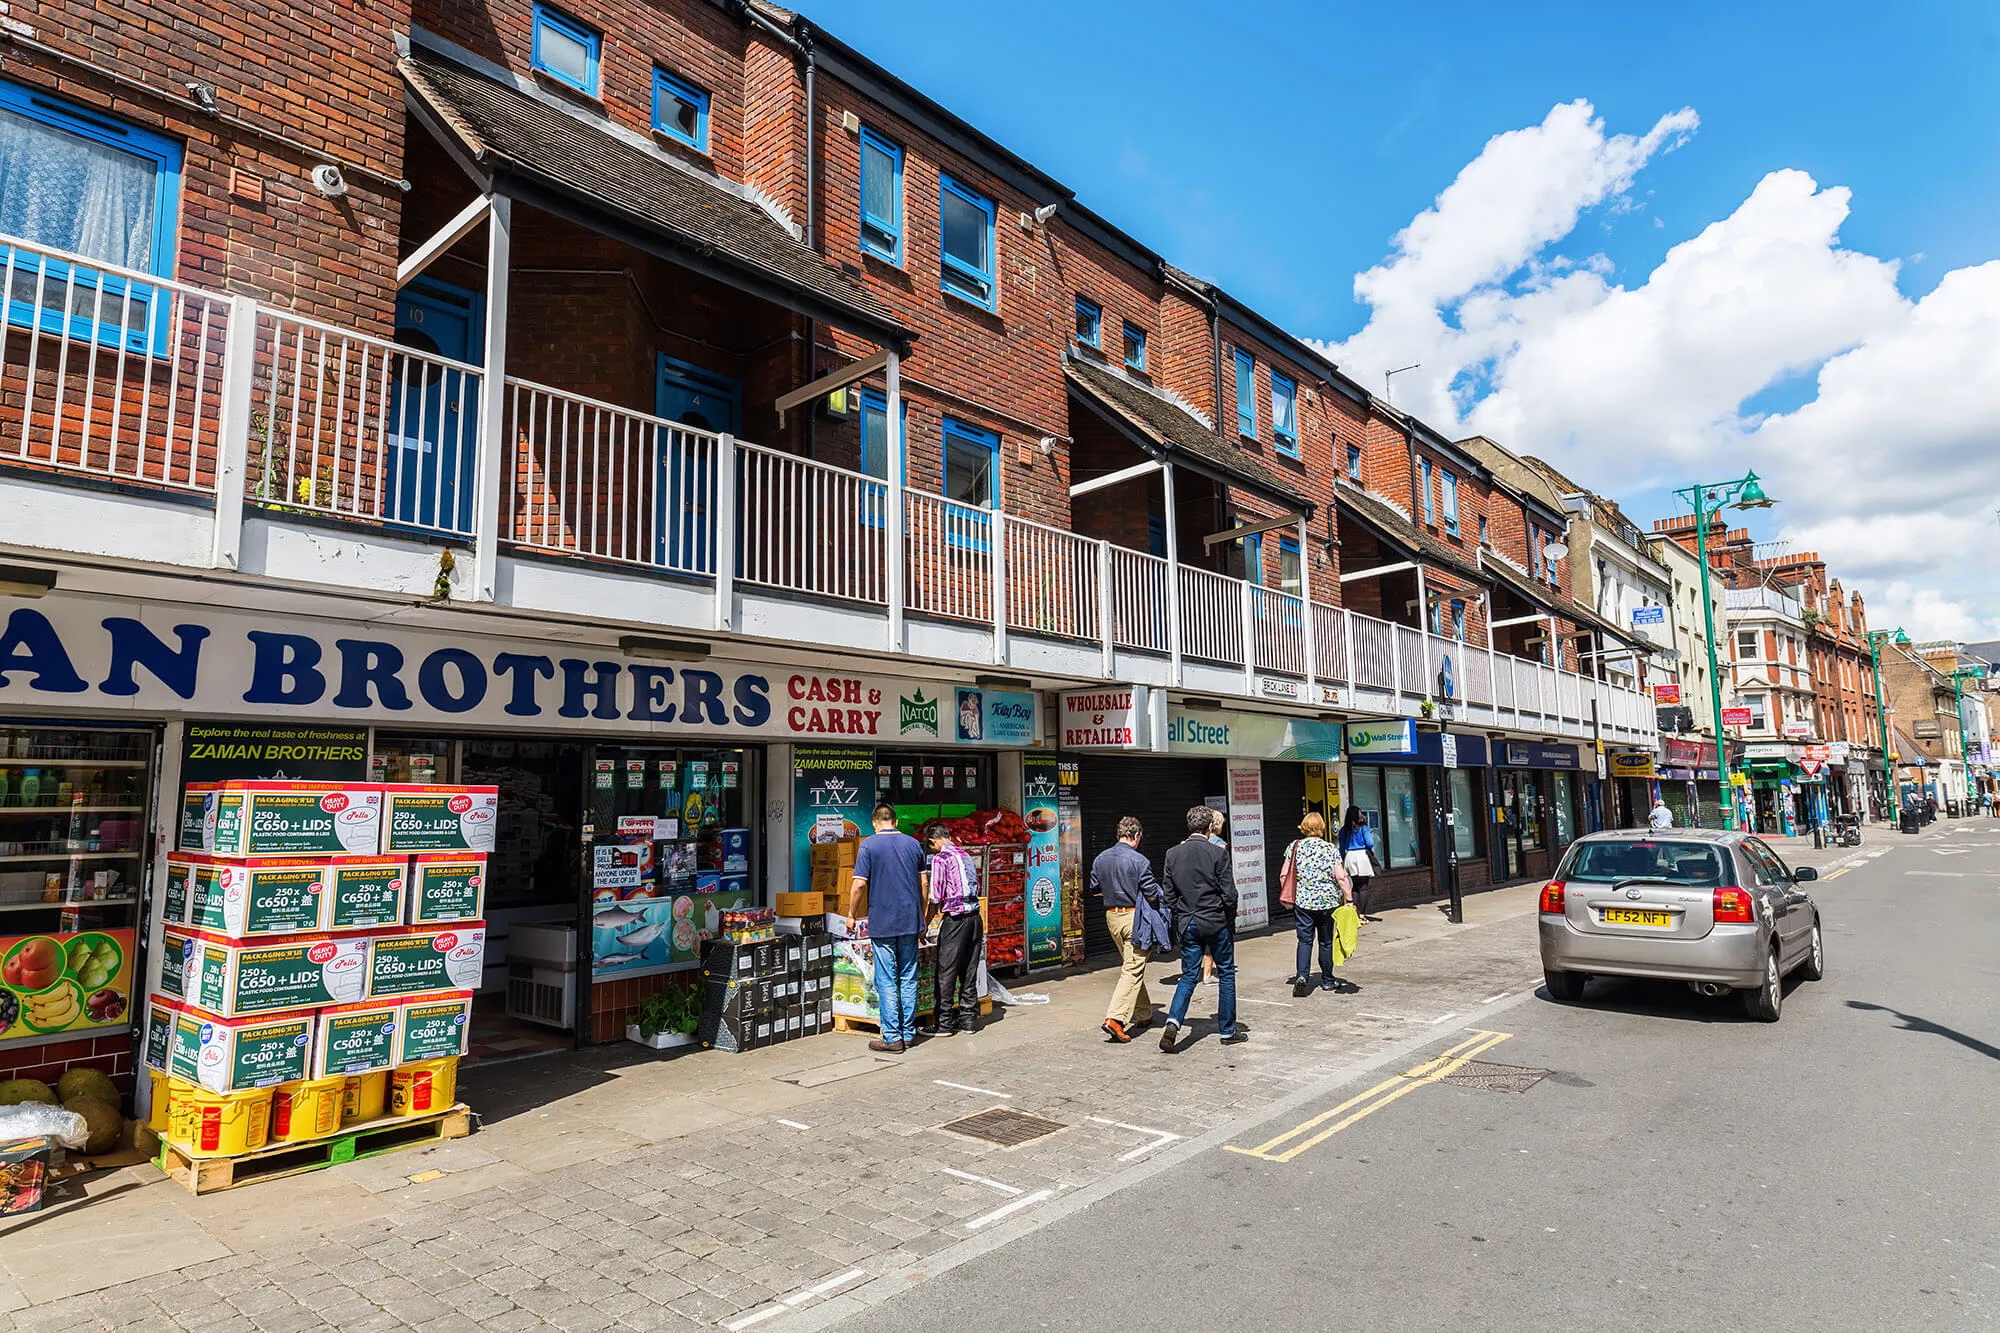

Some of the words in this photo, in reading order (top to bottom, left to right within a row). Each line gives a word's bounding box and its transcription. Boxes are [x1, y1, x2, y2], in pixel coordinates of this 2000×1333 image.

[243, 630, 771, 727] BROTHERS
[787, 674, 862, 704] CASH
[868, 688, 881, 705] &
[1066, 693, 1132, 712] WHOLESALE
[901, 703, 937, 723] NATCO
[1013, 704, 1032, 720] Boy
[787, 706, 881, 735] CARRY
[1092, 714, 1104, 725] &
[190, 727, 231, 738] Explore
[233, 729, 250, 737] the
[251, 729, 270, 738] real
[272, 730, 296, 739] taste
[297, 730, 308, 739] of
[309, 730, 354, 740] freshness
[355, 732, 365, 740] at
[1066, 727, 1132, 745] RETAILER
[1168, 717, 1184, 742] all
[1187, 719, 1229, 745] Street
[1371, 734, 1386, 742] Wall
[1387, 733, 1409, 741] Street
[189, 744, 263, 759] ZAMAN
[264, 745, 364, 761] BROTHERS
[794, 759, 826, 769] ZAMAN
[827, 759, 873, 770] BROTHERS
[1058, 763, 1071, 771] THIS
[1025, 783, 1056, 796] TAZ
[325, 797, 345, 805] HEAVY
[810, 789, 859, 805] TAZ
[254, 821, 289, 831] C650
[291, 822, 300, 830] +
[303, 820, 332, 830] LIDS
[394, 820, 422, 829] C650
[424, 821, 432, 829] +
[434, 820, 458, 829] LIDS
[342, 893, 370, 903] C650
[427, 889, 453, 898] C650
[257, 898, 288, 907] C650
[1606, 911, 1640, 922] LF52
[1643, 913, 1669, 924] NFT
[437, 936, 454, 944] HEAVY
[312, 945, 333, 955] HEAVY
[314, 951, 332, 960] DUTY
[376, 963, 405, 974] C650
[418, 959, 442, 970] LIDS
[241, 969, 259, 978] 250
[240, 976, 275, 989] C650
[278, 976, 287, 985] +
[290, 971, 319, 984] LIDS
[354, 1001, 388, 1009] IMPROVED
[410, 1029, 436, 1039] C500
[261, 1043, 277, 1051] 250
[334, 1039, 362, 1050] C500
[241, 1052, 273, 1065] C500
[275, 1051, 283, 1059] +
